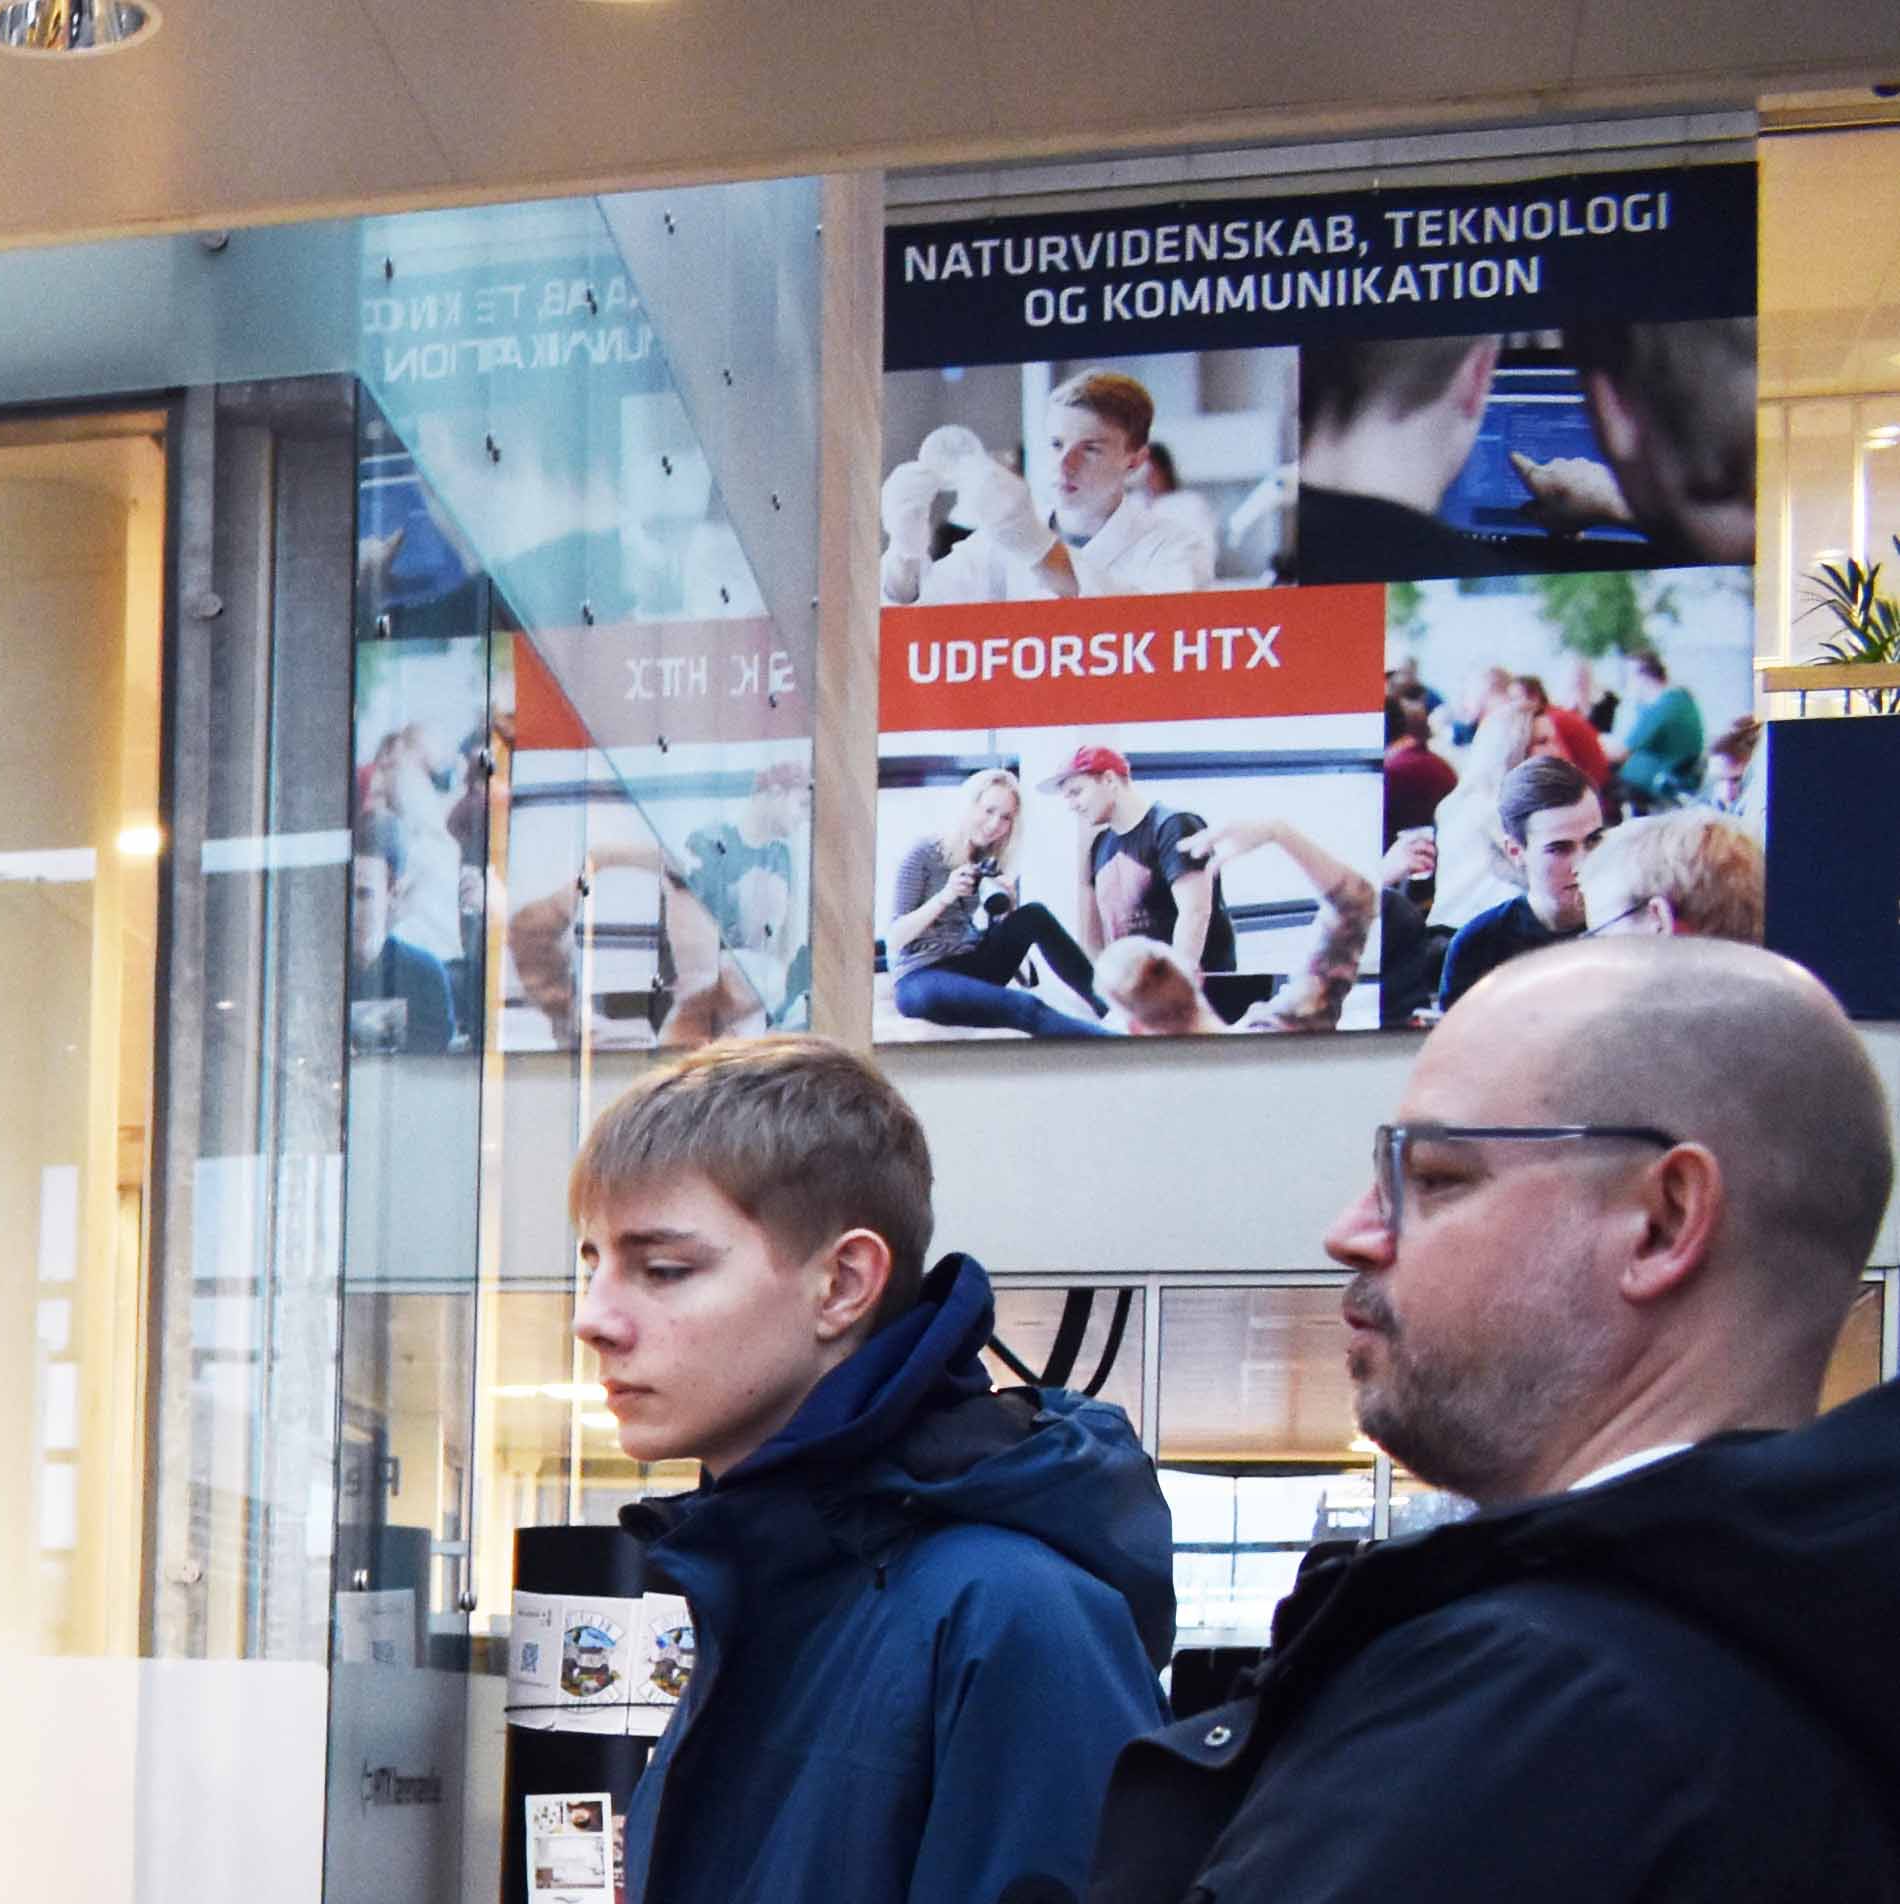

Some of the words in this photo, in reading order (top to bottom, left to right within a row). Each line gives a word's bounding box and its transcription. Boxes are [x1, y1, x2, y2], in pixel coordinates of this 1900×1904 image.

[904, 215, 1368, 283] NATURVIDENSKAB,
[1384, 191, 1670, 249] TEKNOLOGI
[1023, 286, 1088, 327] OG
[1102, 254, 1542, 323] KOMMUNIKATION
[907, 631, 1156, 684] UDFORSK
[1172, 625, 1282, 673] HTX
